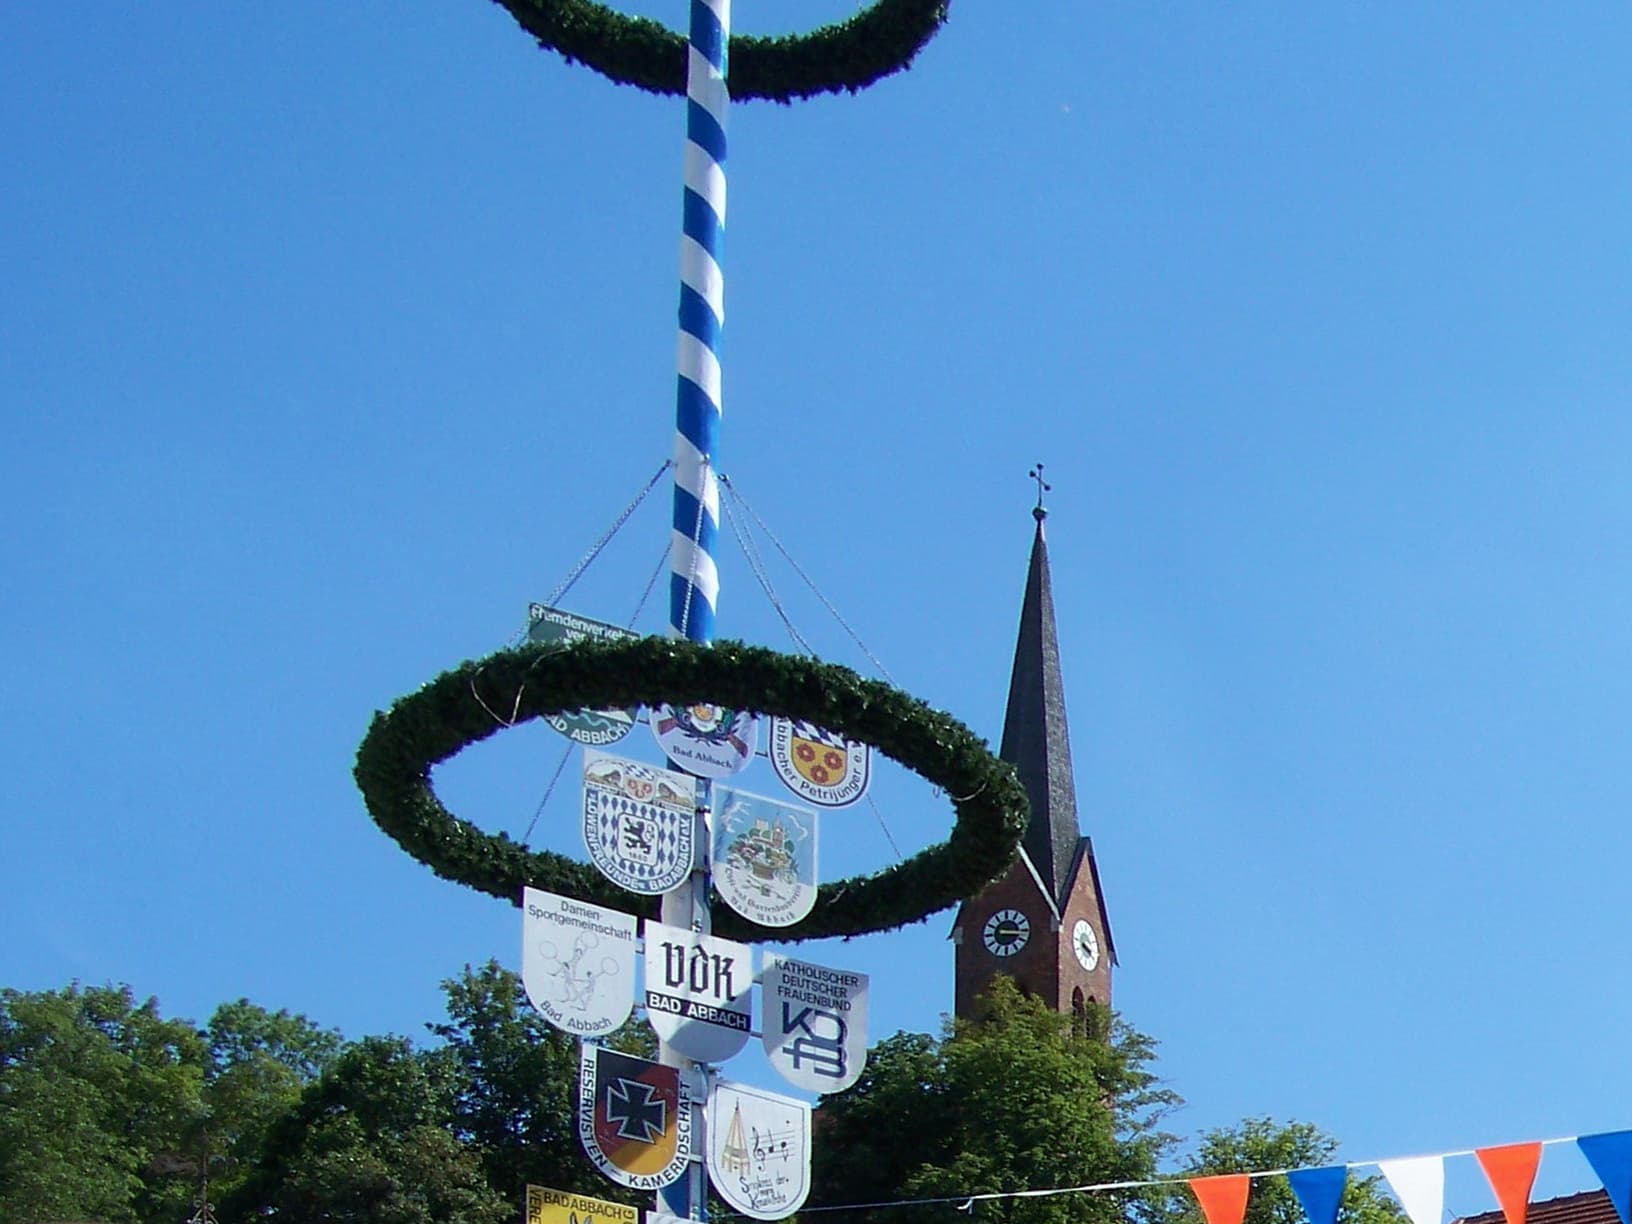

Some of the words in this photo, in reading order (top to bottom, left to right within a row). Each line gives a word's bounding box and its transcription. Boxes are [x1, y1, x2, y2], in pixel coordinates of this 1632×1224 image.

[570, 722, 630, 744] ABBACH
[672, 745, 693, 759] Bad
[528, 904, 633, 941] Sportgemeinschaft
[774, 959, 859, 987] KATHOLISCHER
[782, 973, 848, 998] DEUTSCHER
[649, 994, 682, 1013] BAD
[687, 1003, 747, 1030] ABBACH
[777, 986, 852, 1012] FRAUENBUND
[540, 1000, 563, 1021] Bad
[567, 1017, 612, 1032] Abbach
[628, 1080, 691, 1188] KAMERADSCHAFT
[543, 1190, 569, 1208] BAD
[569, 1198, 623, 1220] ABBACH
